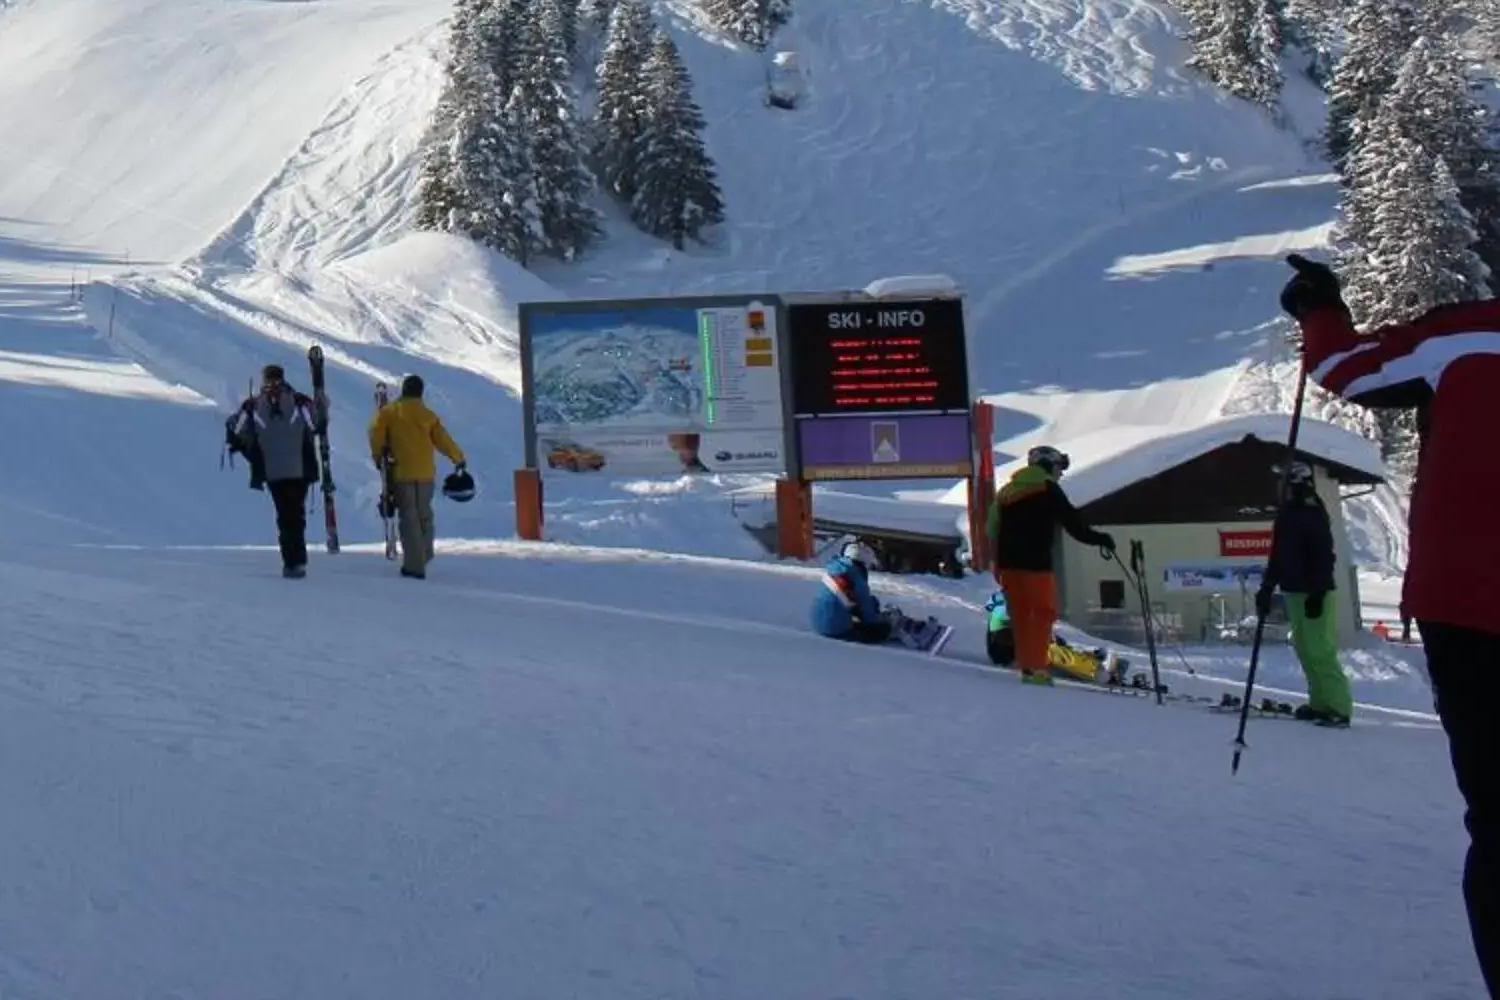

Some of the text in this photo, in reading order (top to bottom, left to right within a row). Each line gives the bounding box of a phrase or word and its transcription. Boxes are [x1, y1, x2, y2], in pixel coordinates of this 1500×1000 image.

[827, 311, 861, 329] SKI
[878, 309, 925, 328] INFO
[1225, 538, 1272, 549] ROSSIGN
